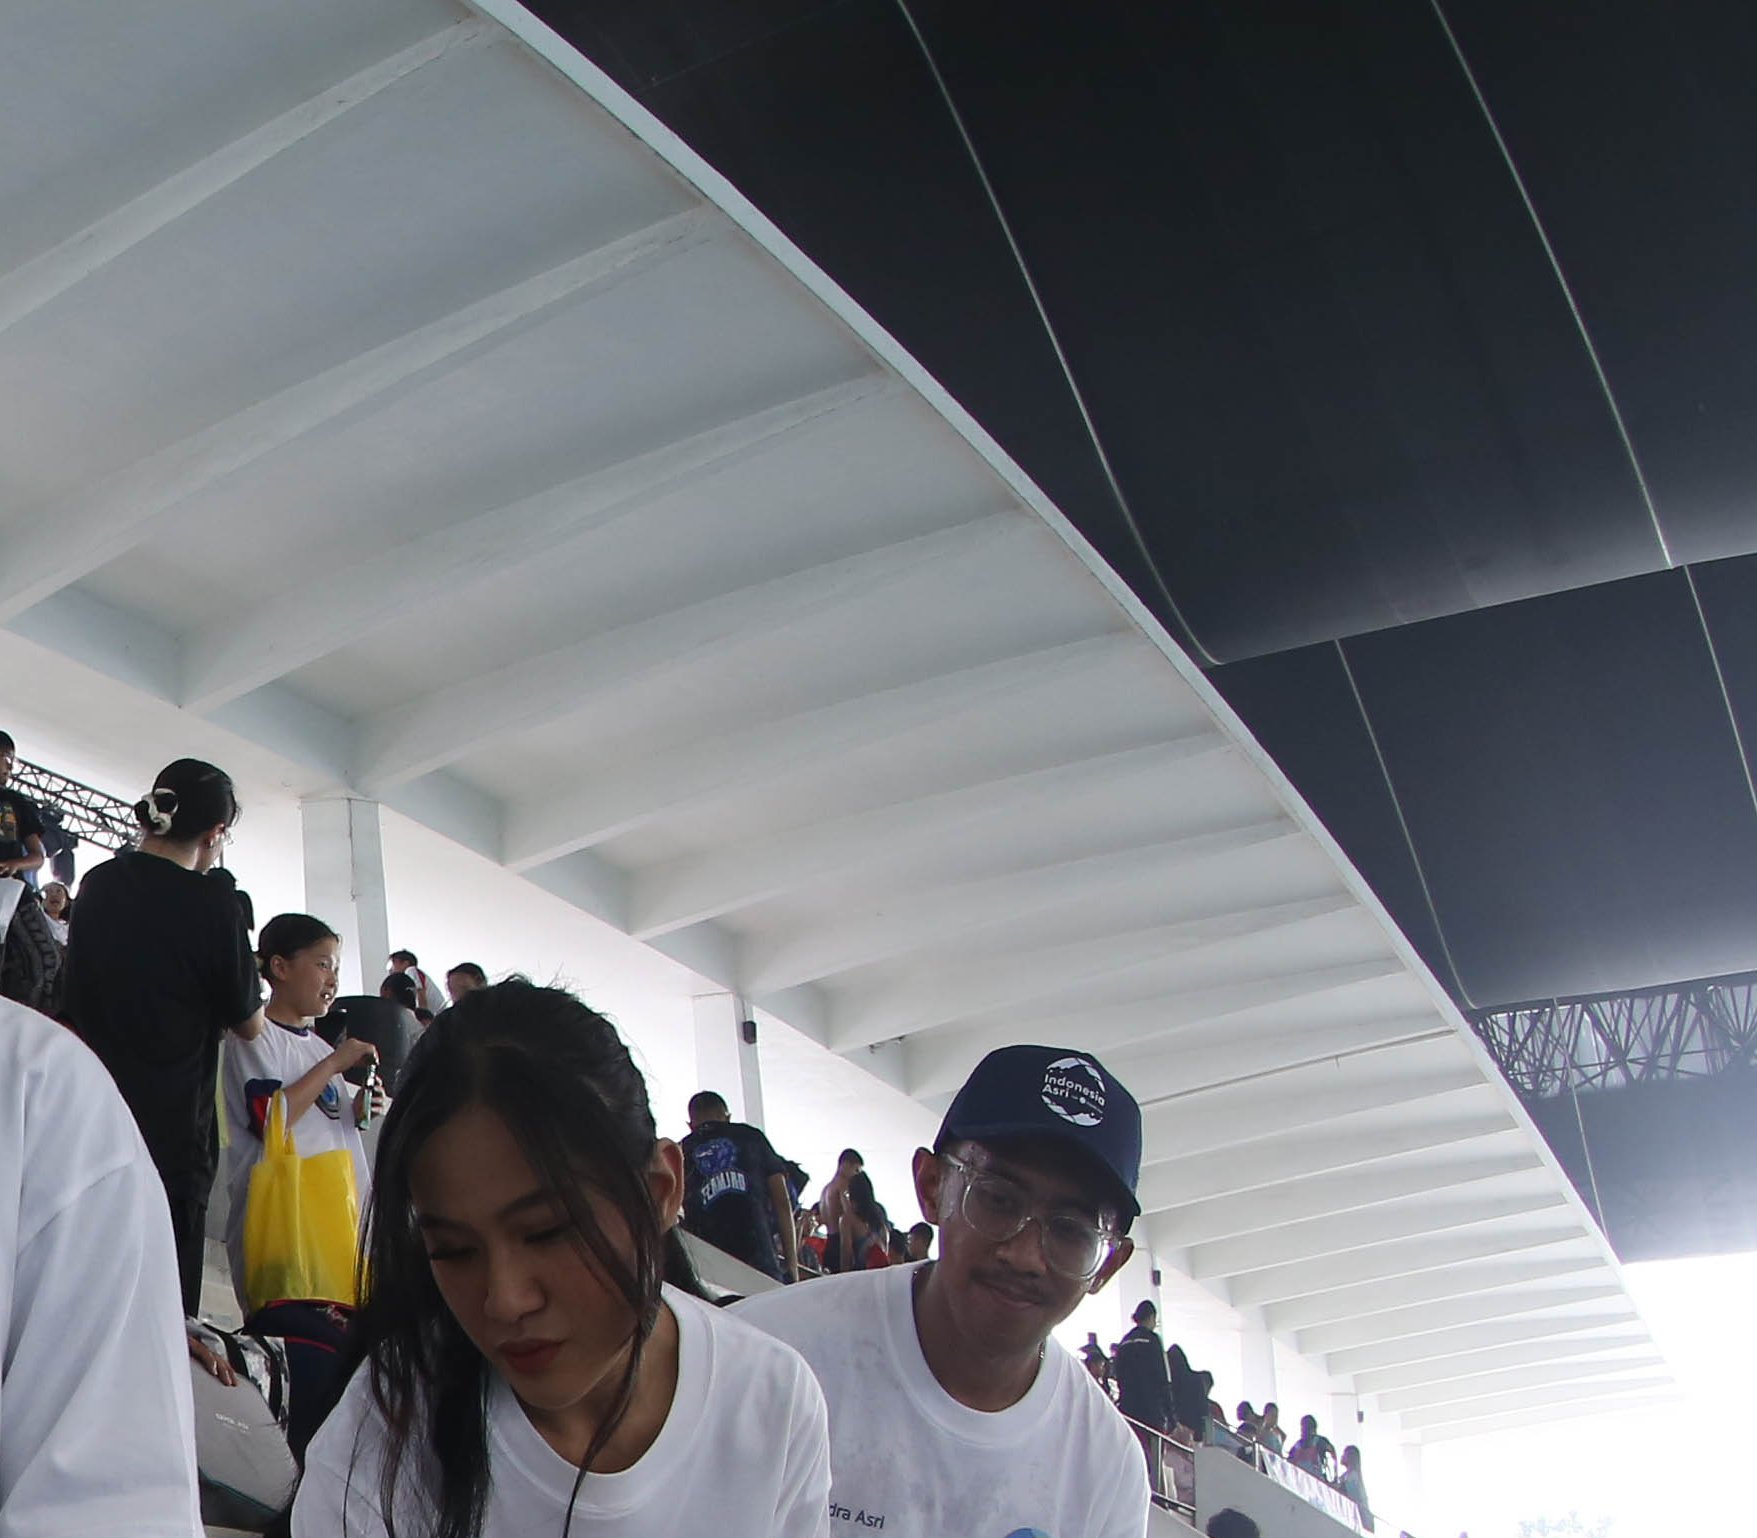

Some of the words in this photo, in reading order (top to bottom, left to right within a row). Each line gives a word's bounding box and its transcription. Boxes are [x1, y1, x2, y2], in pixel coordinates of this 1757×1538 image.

[1041, 1083, 1070, 1098] Asri
[1044, 1073, 1106, 1107] Indonesia
[854, 1509, 885, 1530] Asri
